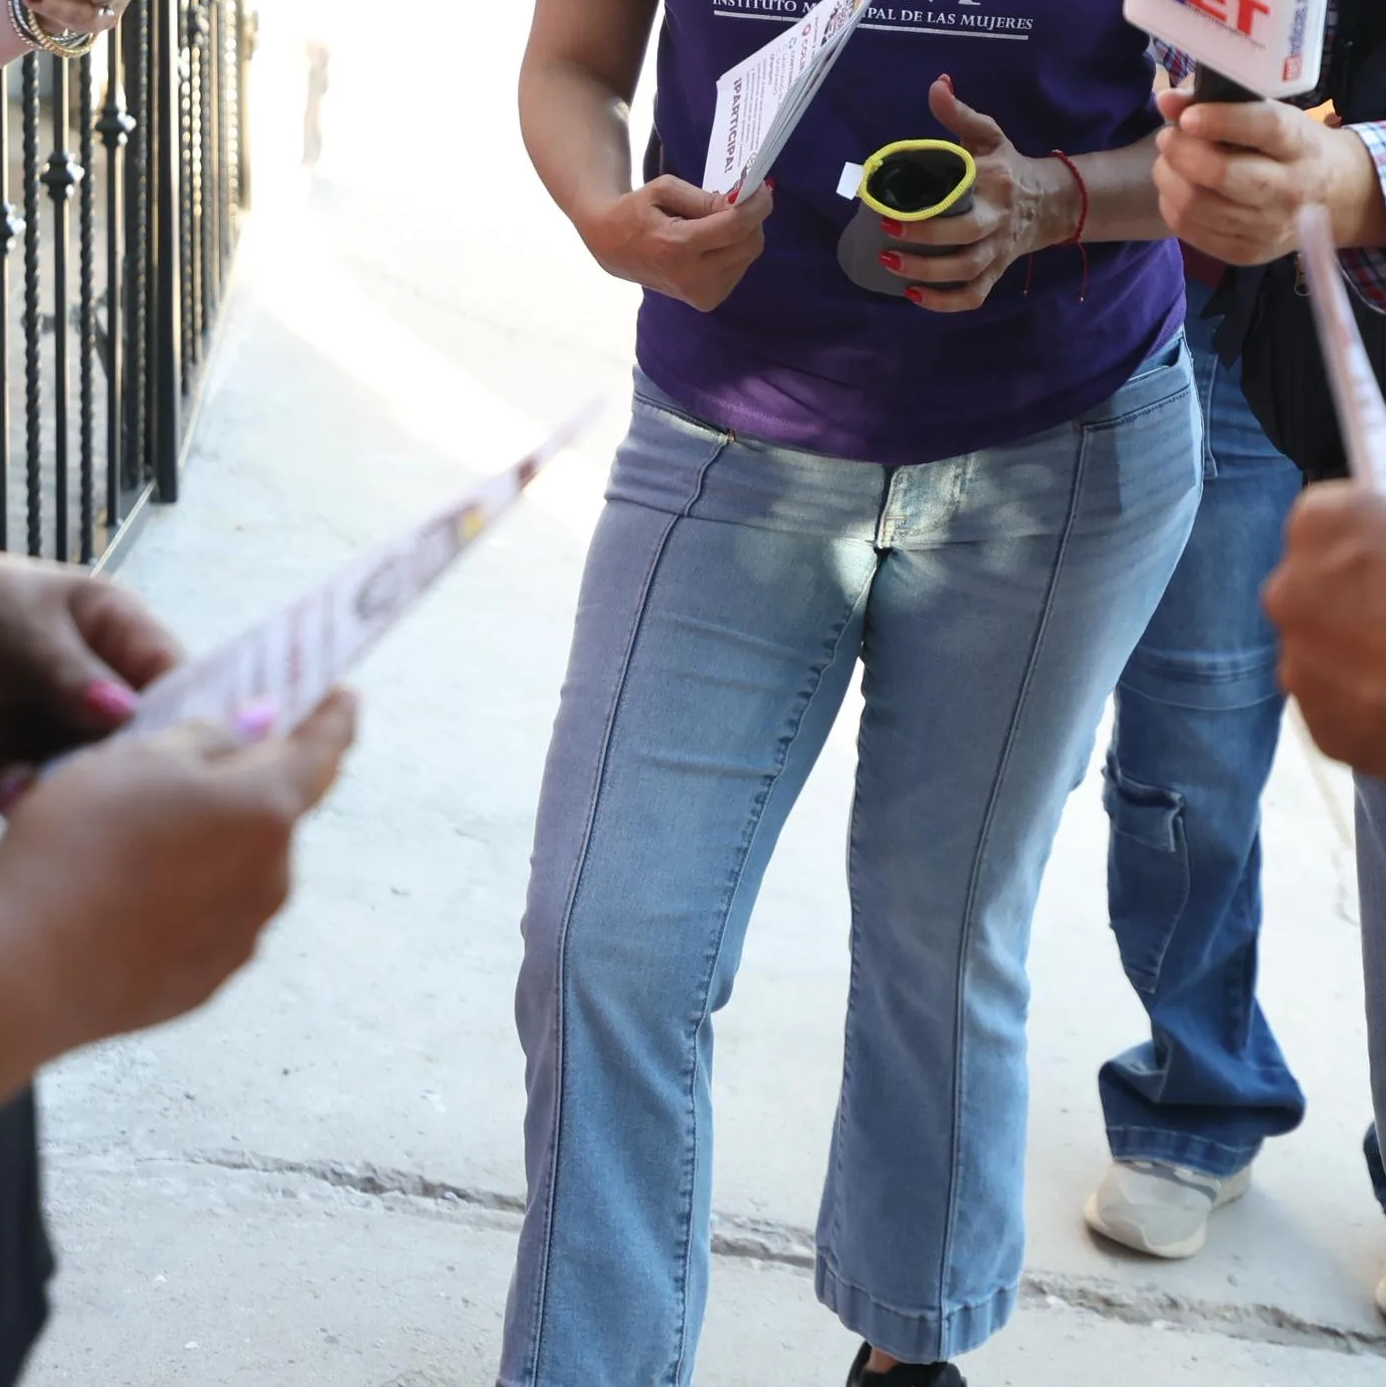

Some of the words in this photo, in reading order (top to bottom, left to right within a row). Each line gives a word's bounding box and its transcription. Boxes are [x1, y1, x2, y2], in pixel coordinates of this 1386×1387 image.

[900, 9, 923, 22] DE
[927, 11, 956, 25] LAS
[960, 14, 1034, 31] MUJERES
